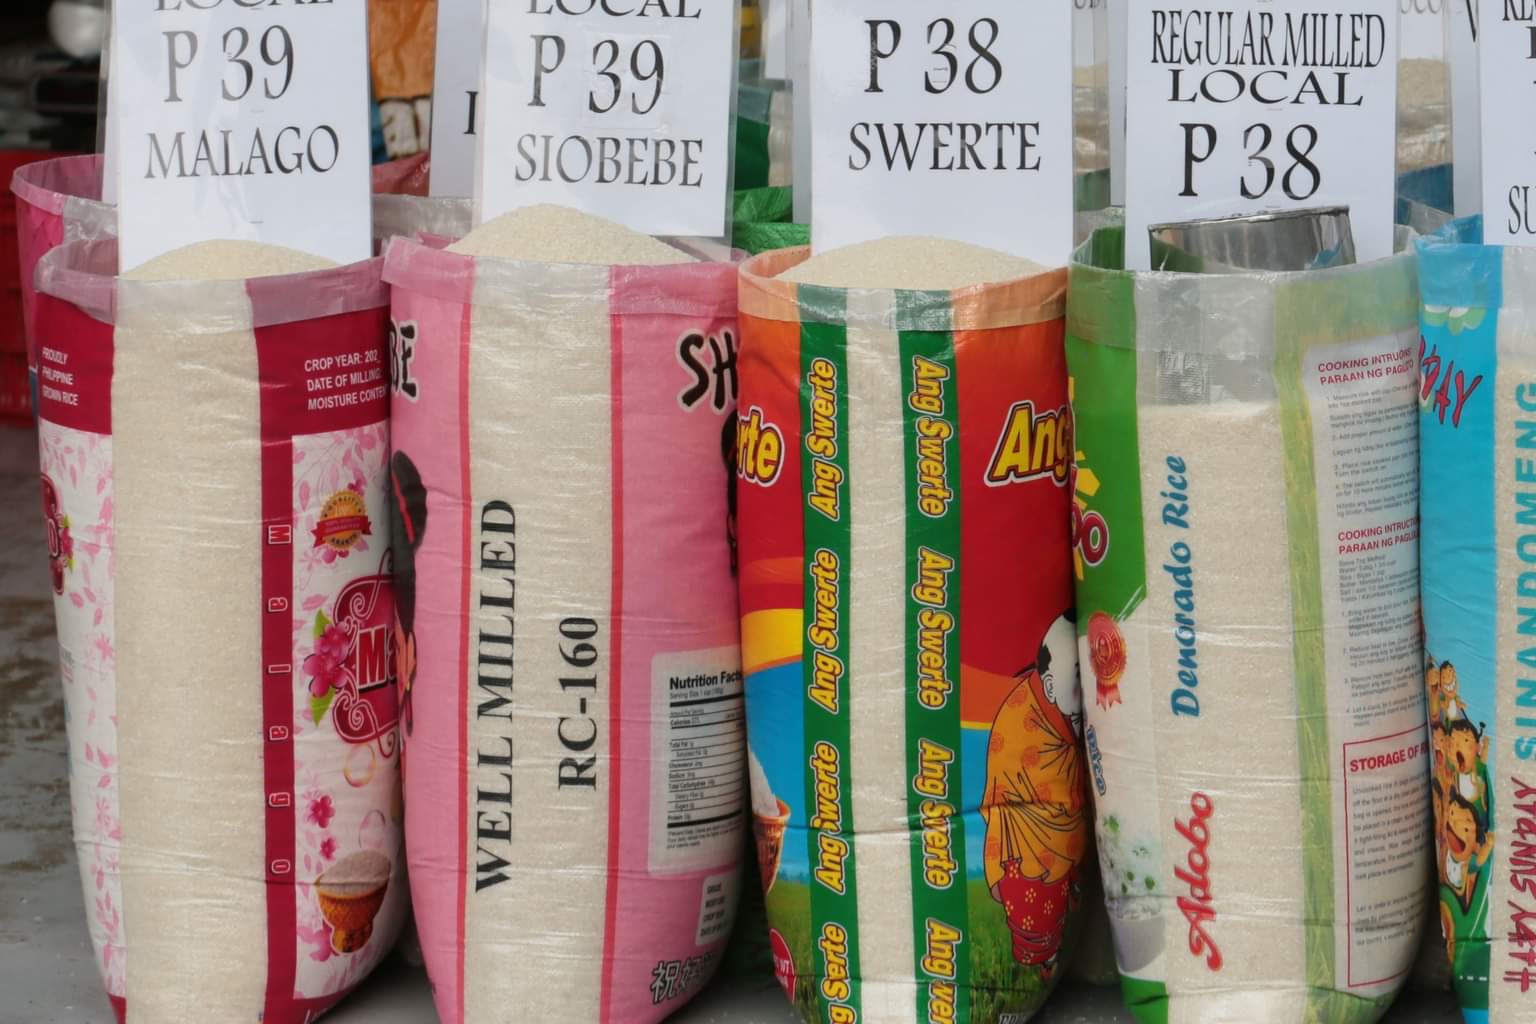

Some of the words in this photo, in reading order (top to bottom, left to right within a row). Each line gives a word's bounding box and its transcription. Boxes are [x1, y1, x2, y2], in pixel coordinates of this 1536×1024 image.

[162, 30, 198, 103] P
[221, 25, 294, 101] 39
[865, 19, 901, 93] P
[924, 17, 1003, 94] 38
[1152, 11, 1276, 67] REGULAR
[1285, 13, 1385, 69] MILLED
[527, 35, 565, 107] P
[587, 39, 665, 115] 39
[1168, 69, 1363, 106] LOCAL
[145, 124, 339, 179] MALAGO
[515, 134, 703, 187] SIOBEBE
[848, 121, 1041, 171] SWERTE
[1178, 123, 1217, 197] P
[1240, 123, 1321, 200] 38
[304, 357, 333, 372] CROP
[335, 352, 363, 367] YEAR:
[307, 376, 333, 392] DATE
[335, 374, 348, 388] OF
[909, 355, 949, 415] Ang
[1318, 358, 1369, 373] COOKING
[1320, 370, 1365, 385] PARAAN
[1367, 369, 1382, 379] NG
[307, 392, 358, 410] MOISTURE
[807, 358, 837, 459] Swerte
[808, 460, 844, 520] Ang
[916, 416, 954, 518] Swerte
[1159, 454, 1191, 529] Rice
[1338, 527, 1383, 542] COOKING
[1339, 542, 1379, 555] PARAAN
[1381, 537, 1393, 547] NG
[808, 549, 840, 651] Swerte
[911, 546, 954, 608] Ang
[476, 499, 516, 722] MILLED
[1161, 540, 1201, 718] Denorado
[670, 674, 718, 690] Nutrition
[808, 651, 844, 714] Ang
[917, 608, 955, 709] Swerte
[557, 616, 599, 791] RC-160
[913, 738, 954, 798] Ang
[1350, 749, 1402, 773] STORAGE
[1404, 745, 1419, 762] OF
[475, 736, 514, 893] WELL
[815, 834, 850, 894] Ang
[1174, 791, 1224, 972] Adobo
[920, 918, 963, 979] Ang
